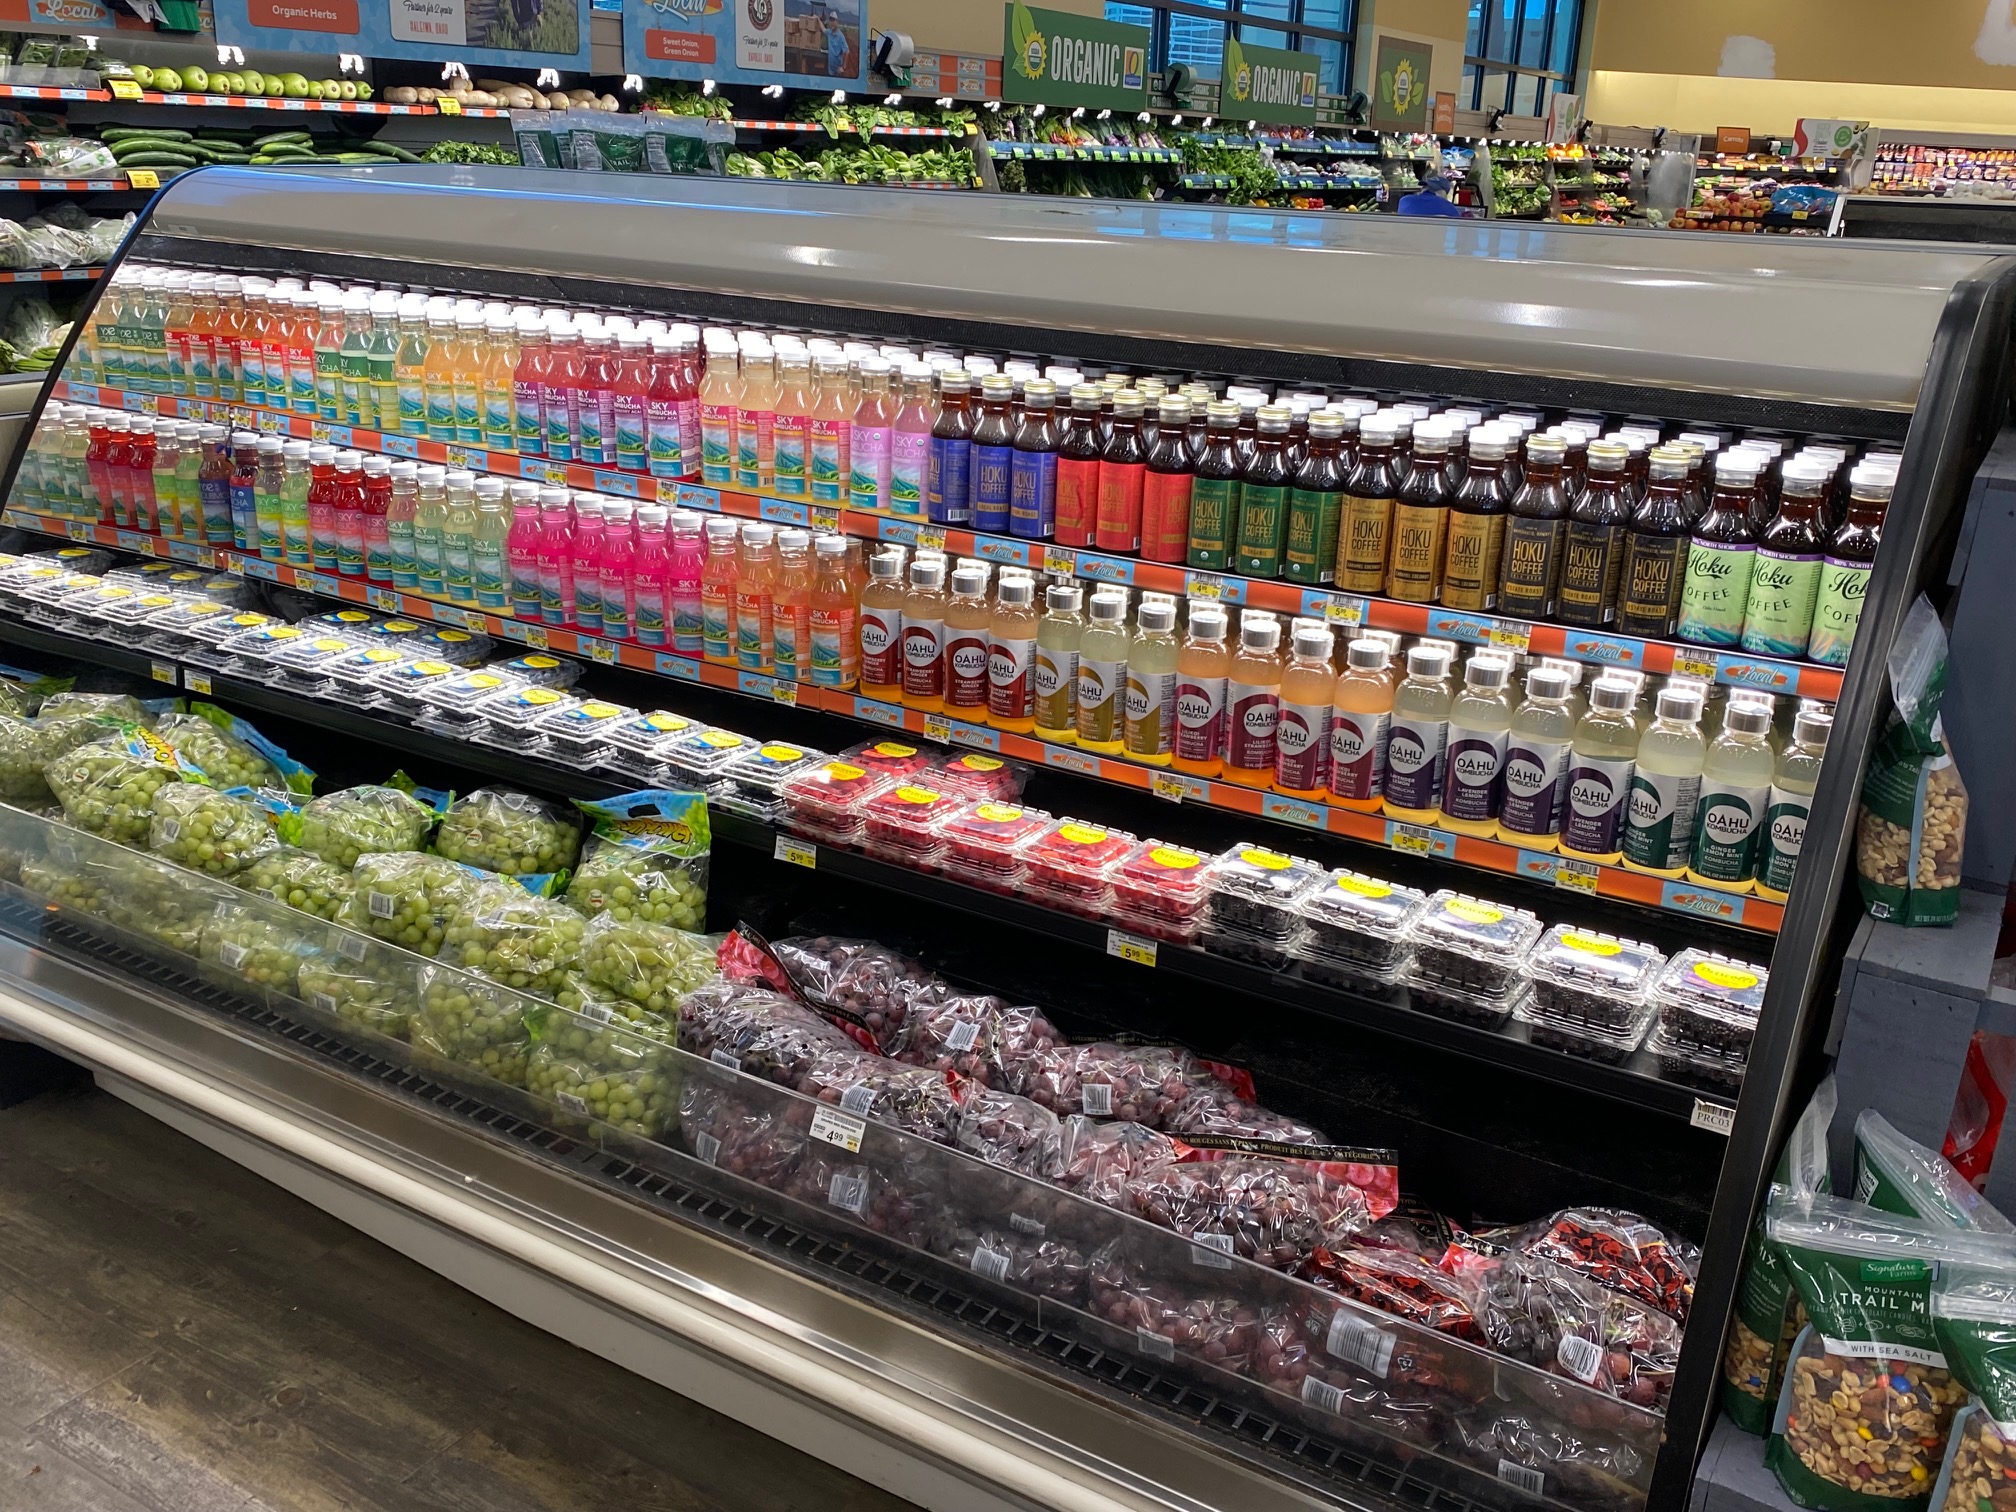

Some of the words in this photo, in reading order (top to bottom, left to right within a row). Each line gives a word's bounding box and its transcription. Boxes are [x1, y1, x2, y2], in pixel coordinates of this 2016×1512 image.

[46, 0, 99, 21] Local
[272, 5, 308, 17] Organic
[309, 9, 337, 20] Herbs
[663, 37, 681, 46] Sweet
[682, 39, 699, 48] Onion,
[664, 47, 681, 55] Green
[682, 49, 699, 57] Onion
[1051, 35, 1120, 87] ORGANIC
[1252, 65, 1300, 106] ORGANIC
[1723, 136, 1744, 144] Carrots
[426, 372, 441, 380] SKY
[484, 378, 499, 386] SKY
[514, 381, 528, 389] SKY
[616, 395, 632, 403] SKY
[651, 402, 668, 410] SKY
[703, 406, 718, 414] SKY
[776, 416, 794, 425] SKY
[813, 420, 828, 430] SKY
[853, 430, 870, 441] SKY
[896, 436, 913, 446] SKY
[981, 466, 1008, 483] HOKU
[1013, 471, 1036, 488] HOKU
[980, 483, 1007, 494] COFFEE
[1013, 489, 1035, 500] COFFEE
[1195, 500, 1222, 520] HOKU
[1246, 506, 1274, 526] HOKU
[1194, 518, 1221, 531] COFFEE
[1291, 512, 1314, 532] HOKU
[1245, 525, 1273, 537] COFFEE
[1352, 520, 1383, 539] HOKU
[474, 539, 489, 547] SKY
[1290, 530, 1313, 543] COFFEE
[1401, 528, 1432, 548] HOKU
[512, 547, 527, 555] SKY
[1351, 539, 1381, 551] COFFEE
[1452, 534, 1482, 556] HOKU
[1513, 540, 1546, 562] HOKU
[1718, 543, 1736, 551] SHORE
[992, 545, 1014, 560] Local
[1400, 547, 1430, 561] COFFEE
[1569, 546, 1600, 568] HOKU
[575, 559, 589, 567] SKY
[1451, 554, 1479, 568] COFFEE
[1511, 560, 1543, 575] COFFEE
[1688, 550, 1732, 579] Hoku
[1568, 566, 1599, 581] COFFEE
[1634, 559, 1669, 581] HOKU
[1752, 559, 1794, 590] Hoku
[636, 574, 652, 582] SKY
[678, 579, 698, 588] SKY
[702, 584, 717, 593] SKY
[1525, 586, 1543, 595] ROAST
[1633, 579, 1667, 594] COFFEE
[1581, 592, 1599, 601] ROAST
[1647, 606, 1665, 614] ROAST
[1750, 596, 1792, 612] OFFEE
[812, 610, 830, 619] SKY
[1447, 620, 1482, 639] Local
[906, 641, 935, 654] OAHU
[1588, 643, 1622, 661] Local
[955, 654, 986, 664] OAHU
[989, 660, 1015, 674] OAHU
[1738, 664, 1777, 686] Local
[867, 704, 891, 722] Local
[1179, 701, 1210, 715] OAHU
[1246, 713, 1278, 723] OAHU
[961, 729, 985, 746] Local
[1278, 726, 1307, 743] OAHU
[1331, 734, 1361, 751] OAHU
[1390, 744, 1422, 760] OAHU
[1060, 754, 1085, 770] Local
[1457, 758, 1495, 771] OAHU
[1456, 767, 1494, 776] KOMBUCHA
[1507, 766, 1543, 783] OAHU
[1572, 787, 1611, 802] OAHU
[1455, 798, 1488, 806] KOMBUCHA
[1509, 802, 1529, 811] LEMON
[1571, 797, 1609, 808] KOMBUCHA
[1281, 803, 1311, 822] Local
[1571, 817, 1602, 826] LAVENDER
[1575, 822, 1596, 831] LEMON
[1708, 812, 1750, 828] OAHU
[1569, 829, 1602, 838] KOMBUCHA
[1706, 823, 1748, 835] KOMBUCHA
[1703, 847, 1725, 857] LEMON
[1710, 845, 1736, 853] GINGER
[1704, 855, 1739, 866] KOMBUCHA
[1684, 894, 1724, 916] Local
[1697, 1112, 1730, 1128] PRC03
[1261, 1143, 1288, 1152] PRODUIT
[1289, 1147, 1303, 1155] DES
[1866, 1263, 1916, 1275] Signature
[1864, 1285, 1923, 1299] MOUNTAIN
[1840, 1292, 1899, 1309] TRAIL
[1851, 1345, 1875, 1353] WITH
[1879, 1346, 1900, 1355] SEA
[1904, 1350, 1932, 1361] SALT
